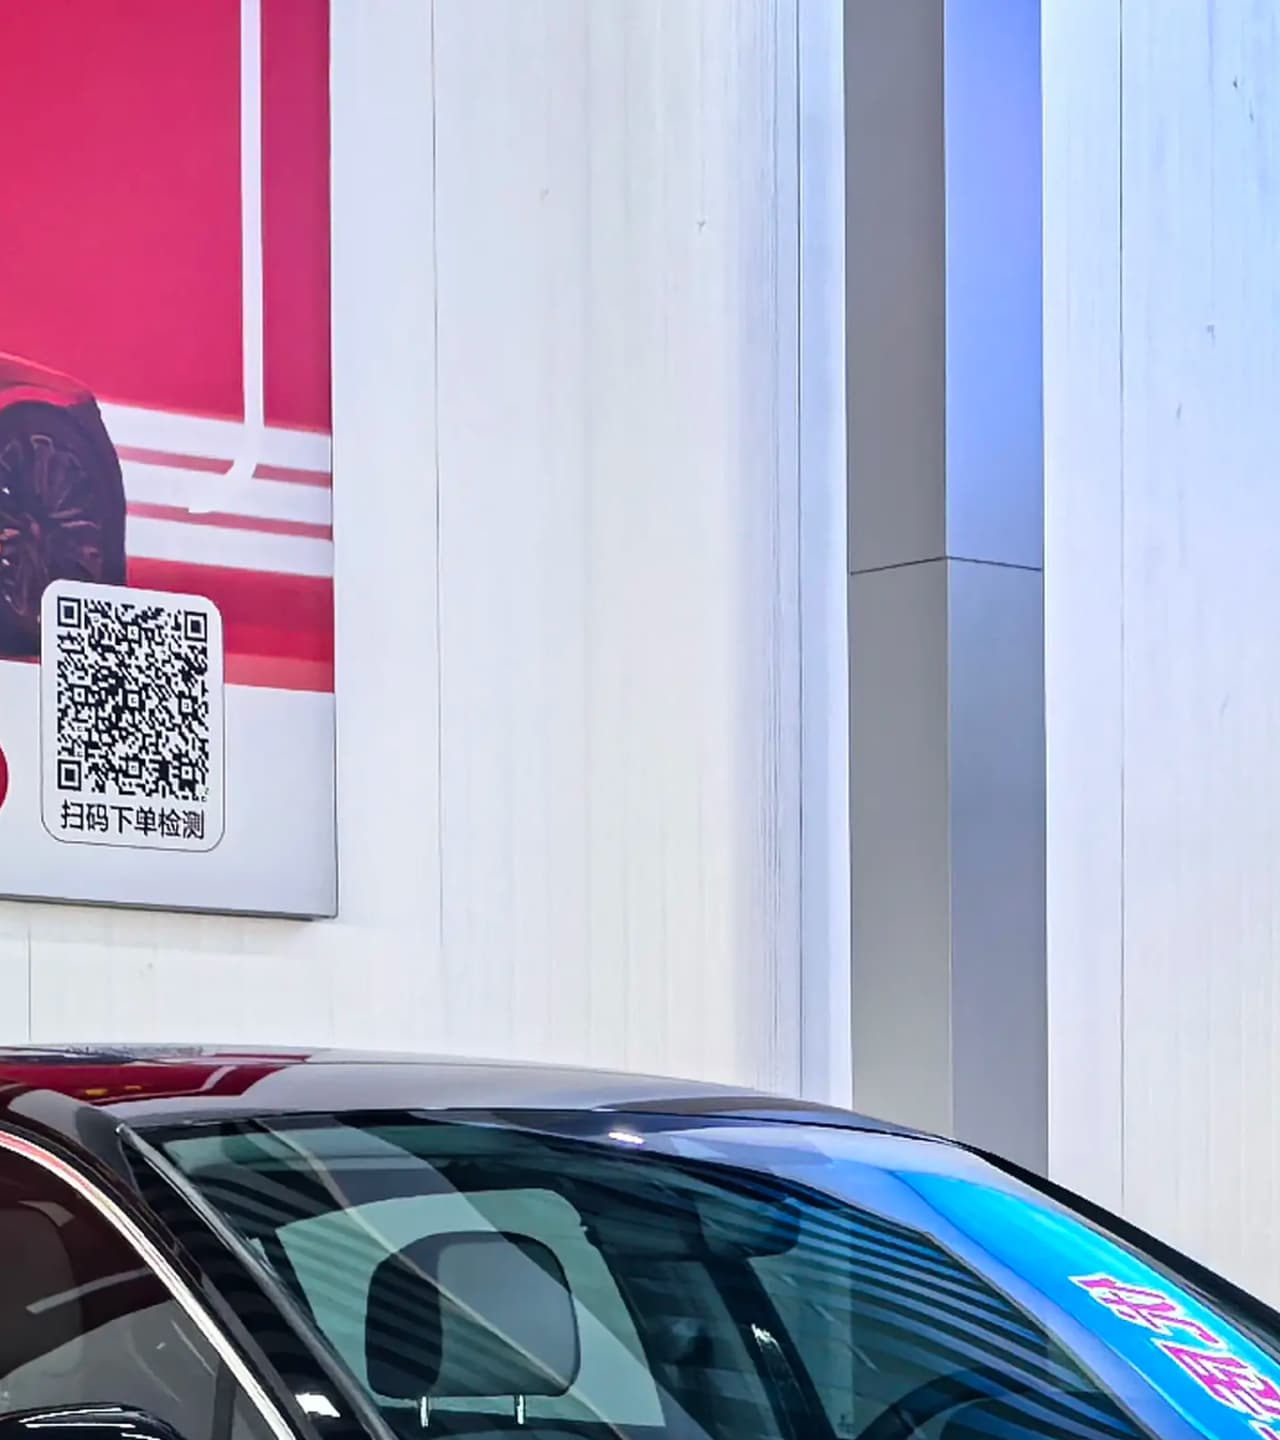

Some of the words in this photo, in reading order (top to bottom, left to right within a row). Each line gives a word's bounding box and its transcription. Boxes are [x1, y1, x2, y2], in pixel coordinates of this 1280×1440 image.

[60, 799, 205, 839] 扫码下单检测
